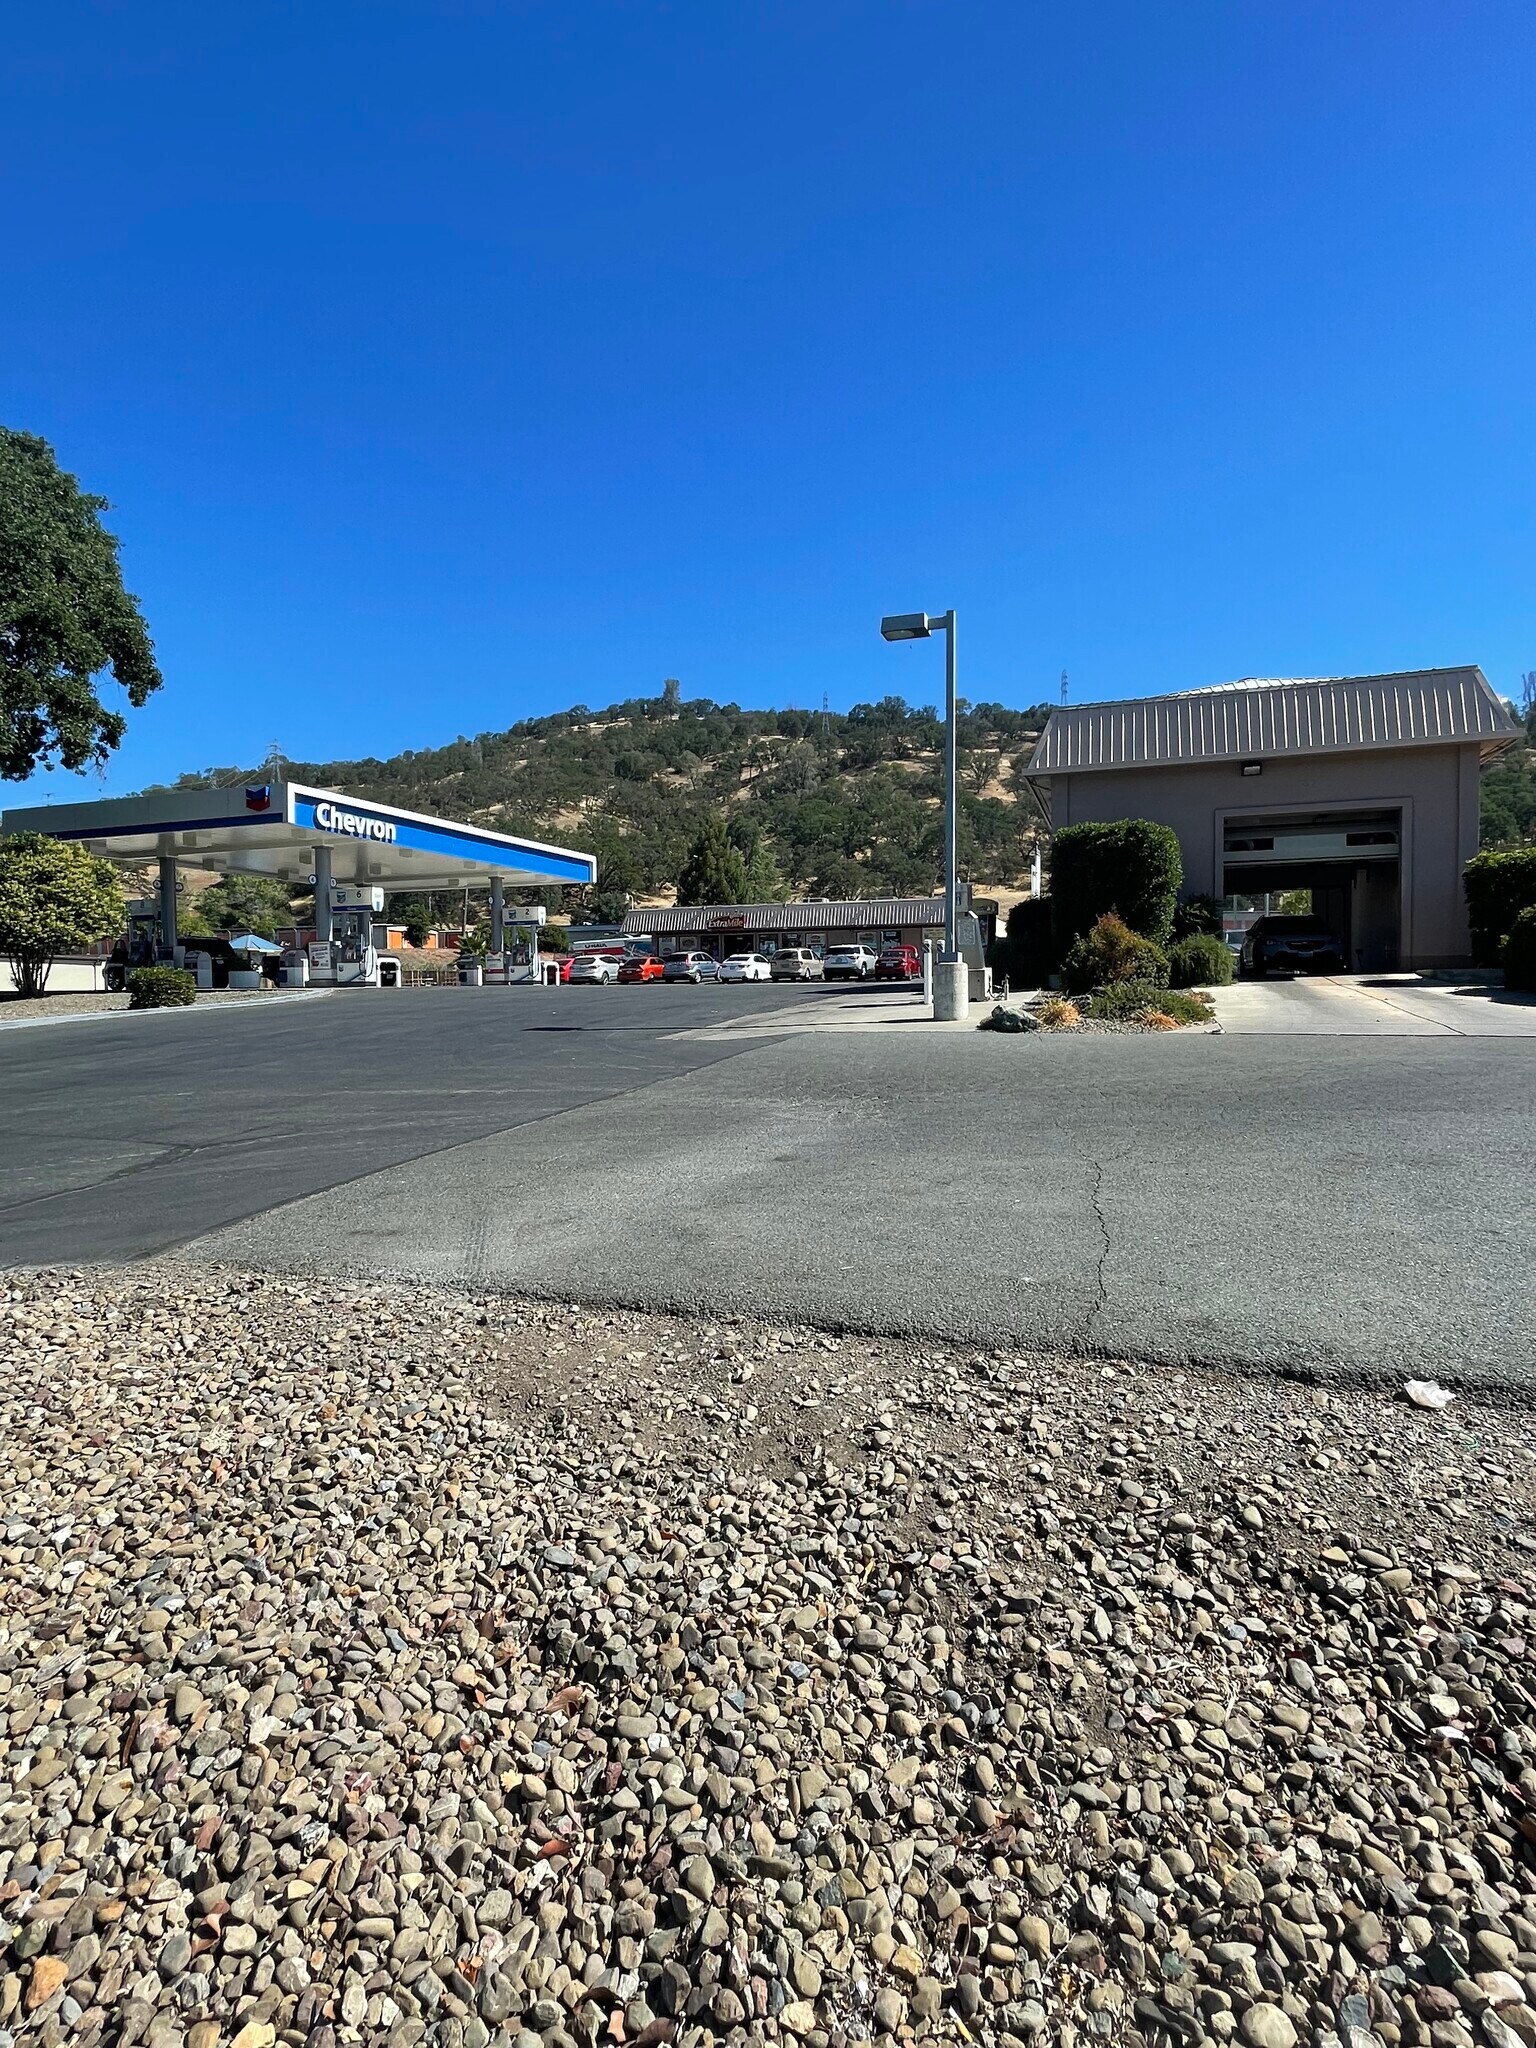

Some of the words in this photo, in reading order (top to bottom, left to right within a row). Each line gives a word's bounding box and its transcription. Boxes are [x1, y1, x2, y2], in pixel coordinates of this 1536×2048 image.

[316, 802, 397, 841] Chevron
[356, 890, 361, 898] 6
[708, 918, 744, 928] ExtraMile
